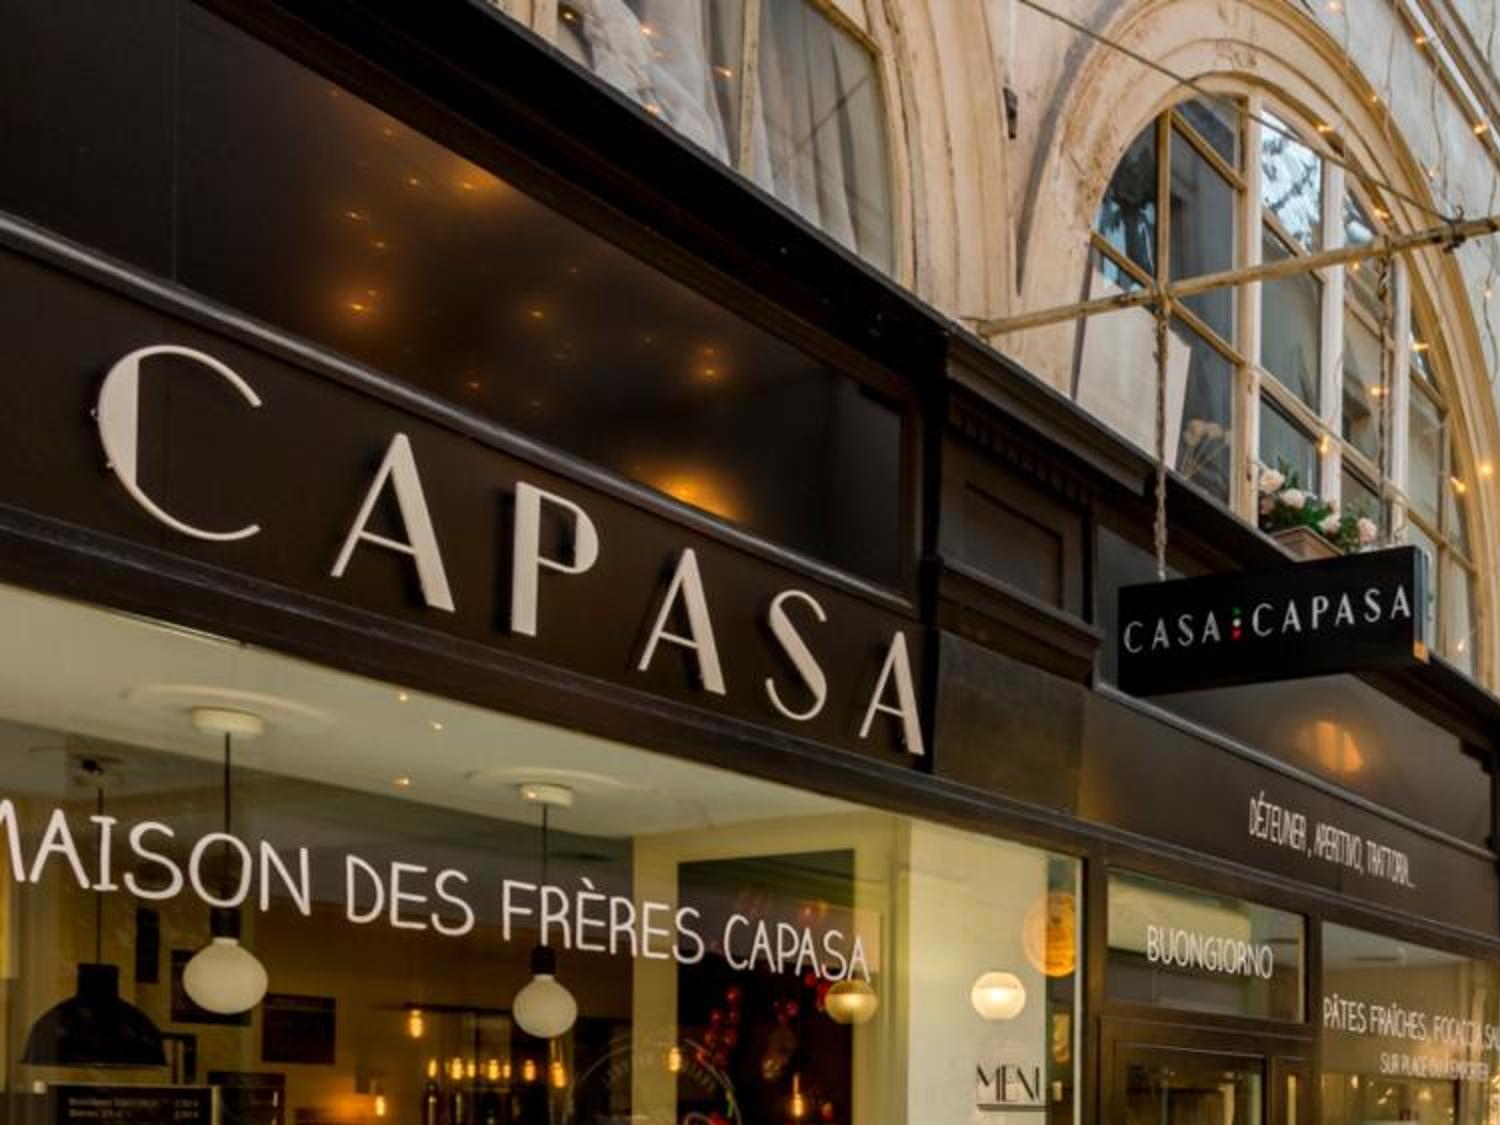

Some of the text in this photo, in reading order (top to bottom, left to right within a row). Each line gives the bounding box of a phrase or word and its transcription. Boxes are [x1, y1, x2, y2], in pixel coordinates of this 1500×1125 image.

[96, 344, 926, 757] CAPASA
[1123, 584, 1412, 654] CASA CAPASA
[345, 854, 475, 937] DES
[502, 877, 706, 965] FRÈRES
[724, 913, 871, 983] CAPASA
[1146, 924, 1274, 980] BUONGIORNO
[1323, 993, 1367, 1034] PÂTES
